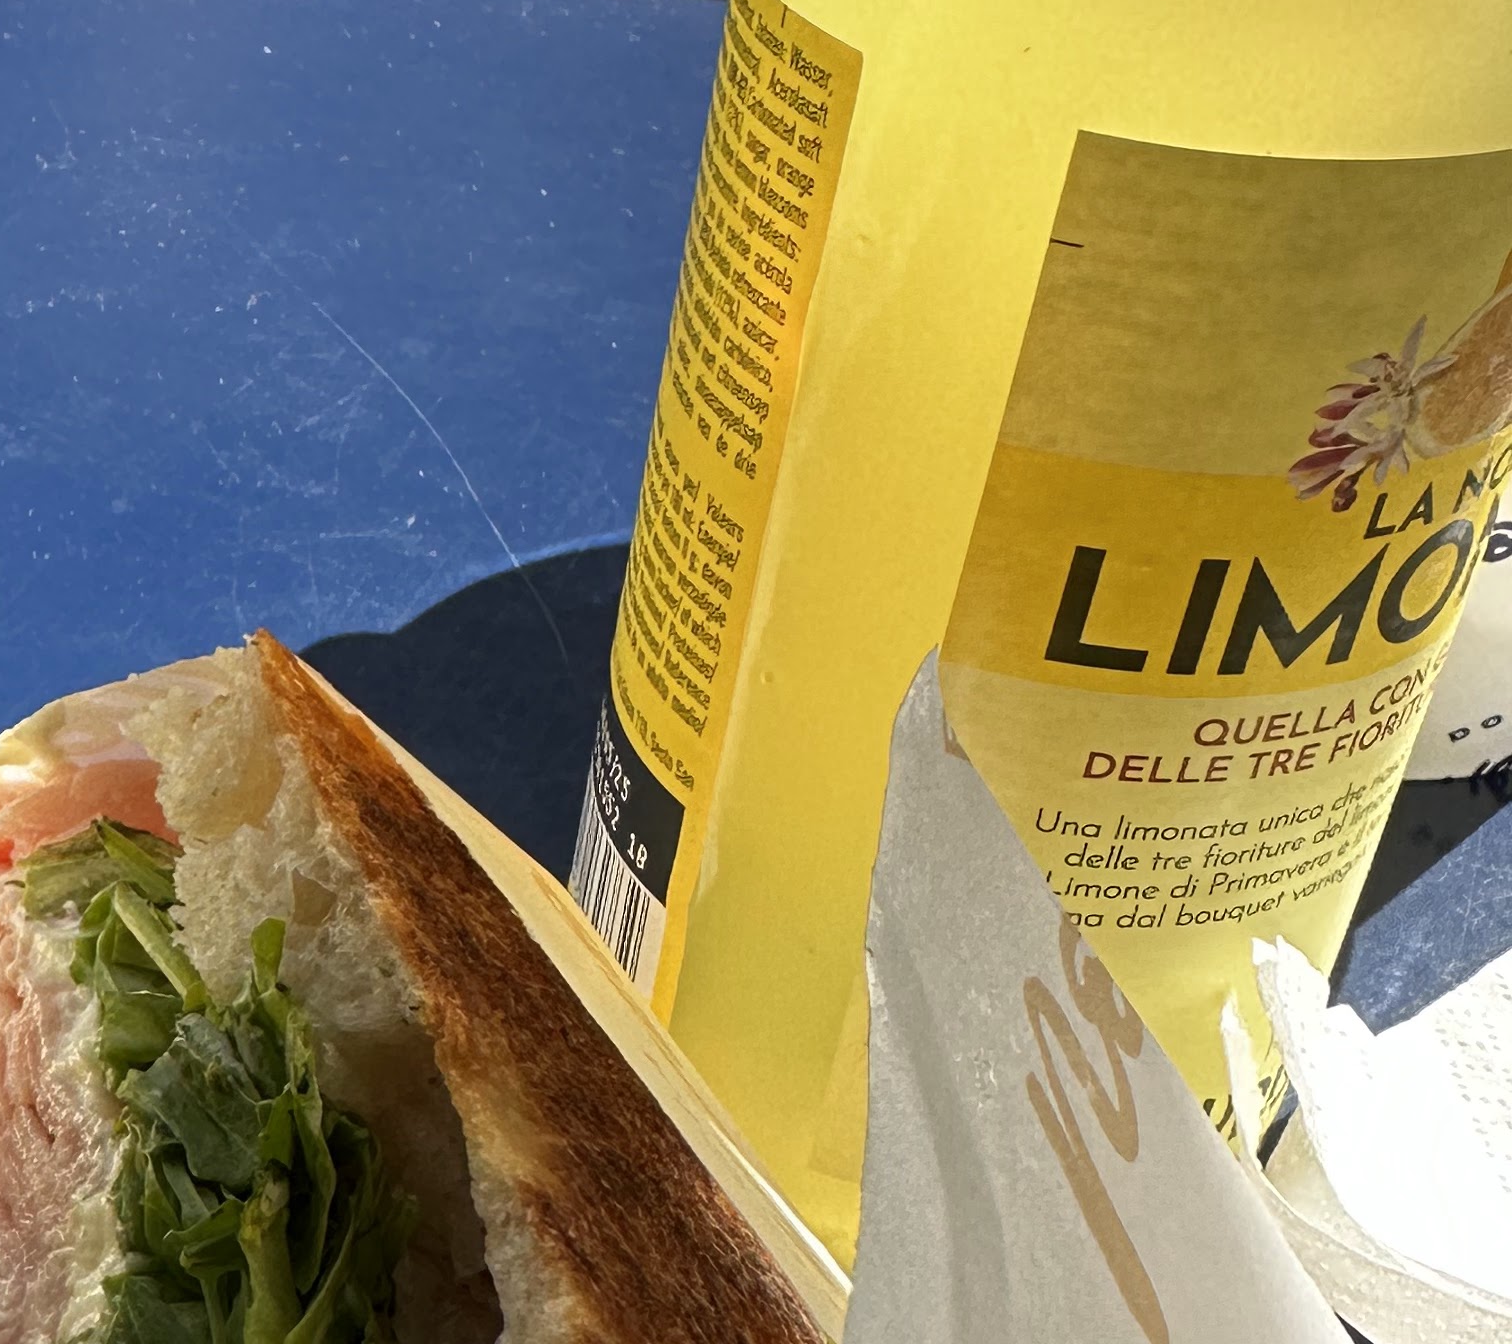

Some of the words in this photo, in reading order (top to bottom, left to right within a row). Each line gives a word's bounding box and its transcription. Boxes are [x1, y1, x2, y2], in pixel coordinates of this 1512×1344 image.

[1363, 480, 1435, 539] LA
[1193, 697, 1357, 747] QUELLA
[1082, 751, 1244, 784] DELLE
[1248, 741, 1323, 781] TRE
[1034, 807, 1103, 840] Una
[1113, 813, 1249, 843] limonata
[1257, 802, 1325, 834] unica
[1063, 843, 1142, 873] delle
[1151, 850, 1193, 873] tre
[1202, 835, 1308, 871] fioriture
[1169, 873, 1200, 898] di
[1208, 847, 1334, 898] Primavera
[1116, 904, 1168, 930] dal
[1174, 894, 1286, 927] bouquet
